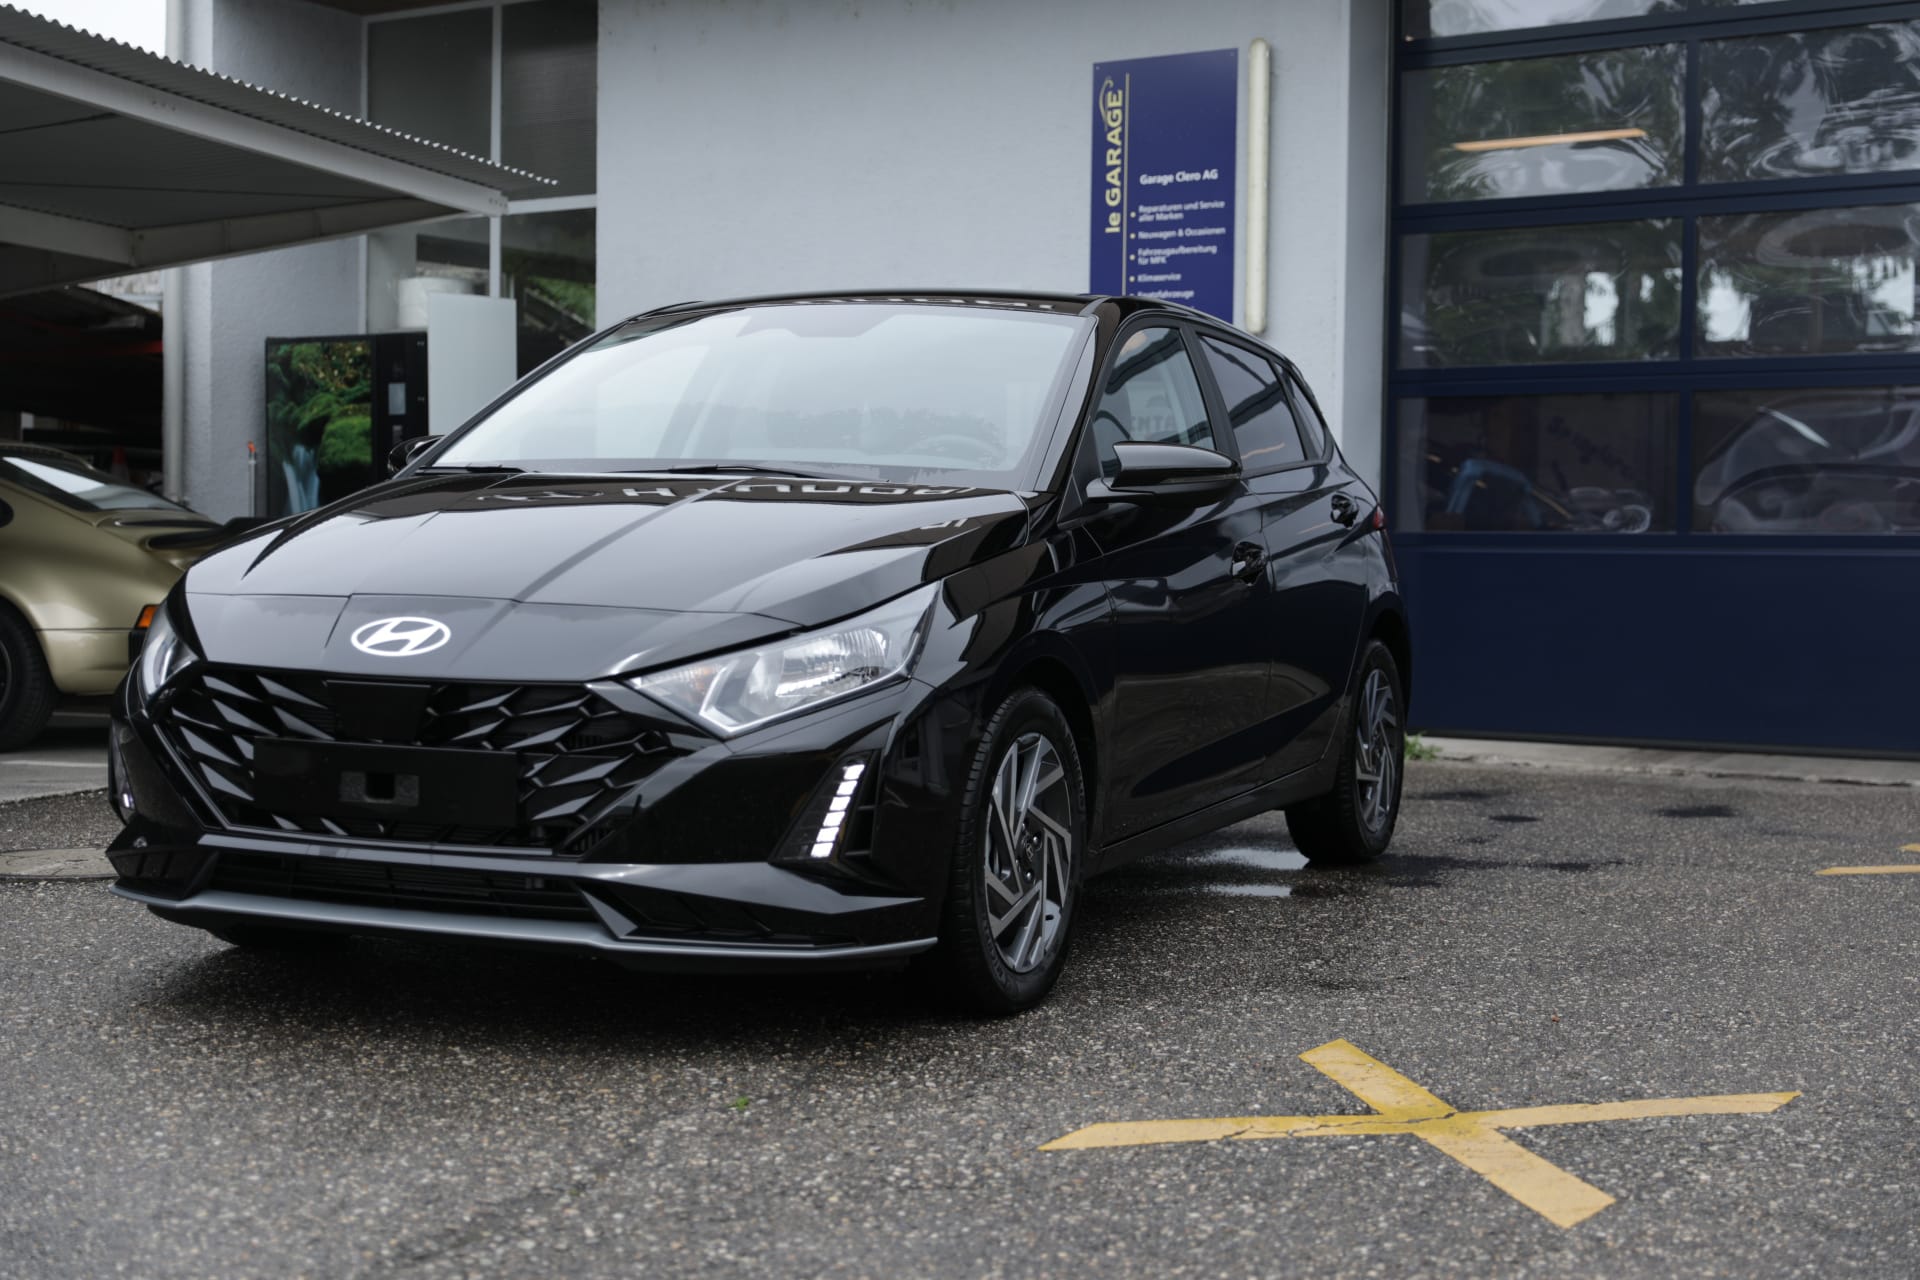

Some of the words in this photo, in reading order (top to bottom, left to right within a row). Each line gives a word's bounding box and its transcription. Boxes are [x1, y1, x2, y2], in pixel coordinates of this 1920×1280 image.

[1105, 89, 1123, 207] GARAGE
[1140, 174, 1174, 186] Garage
[1202, 168, 1218, 180] AG
[1138, 203, 1183, 214] Reparaturen
[1184, 201, 1198, 210] und
[1199, 200, 1225, 209] Service
[1105, 213, 1120, 233] le
[1156, 212, 1183, 221] Marken
[1138, 230, 1176, 240] Neuwagen
[1185, 227, 1226, 237] Occasionen
[1138, 245, 1217, 257] Fahrzeugaufbereitung
[1150, 256, 1167, 264] MFK
[1137, 273, 1181, 283] Klimaservice
